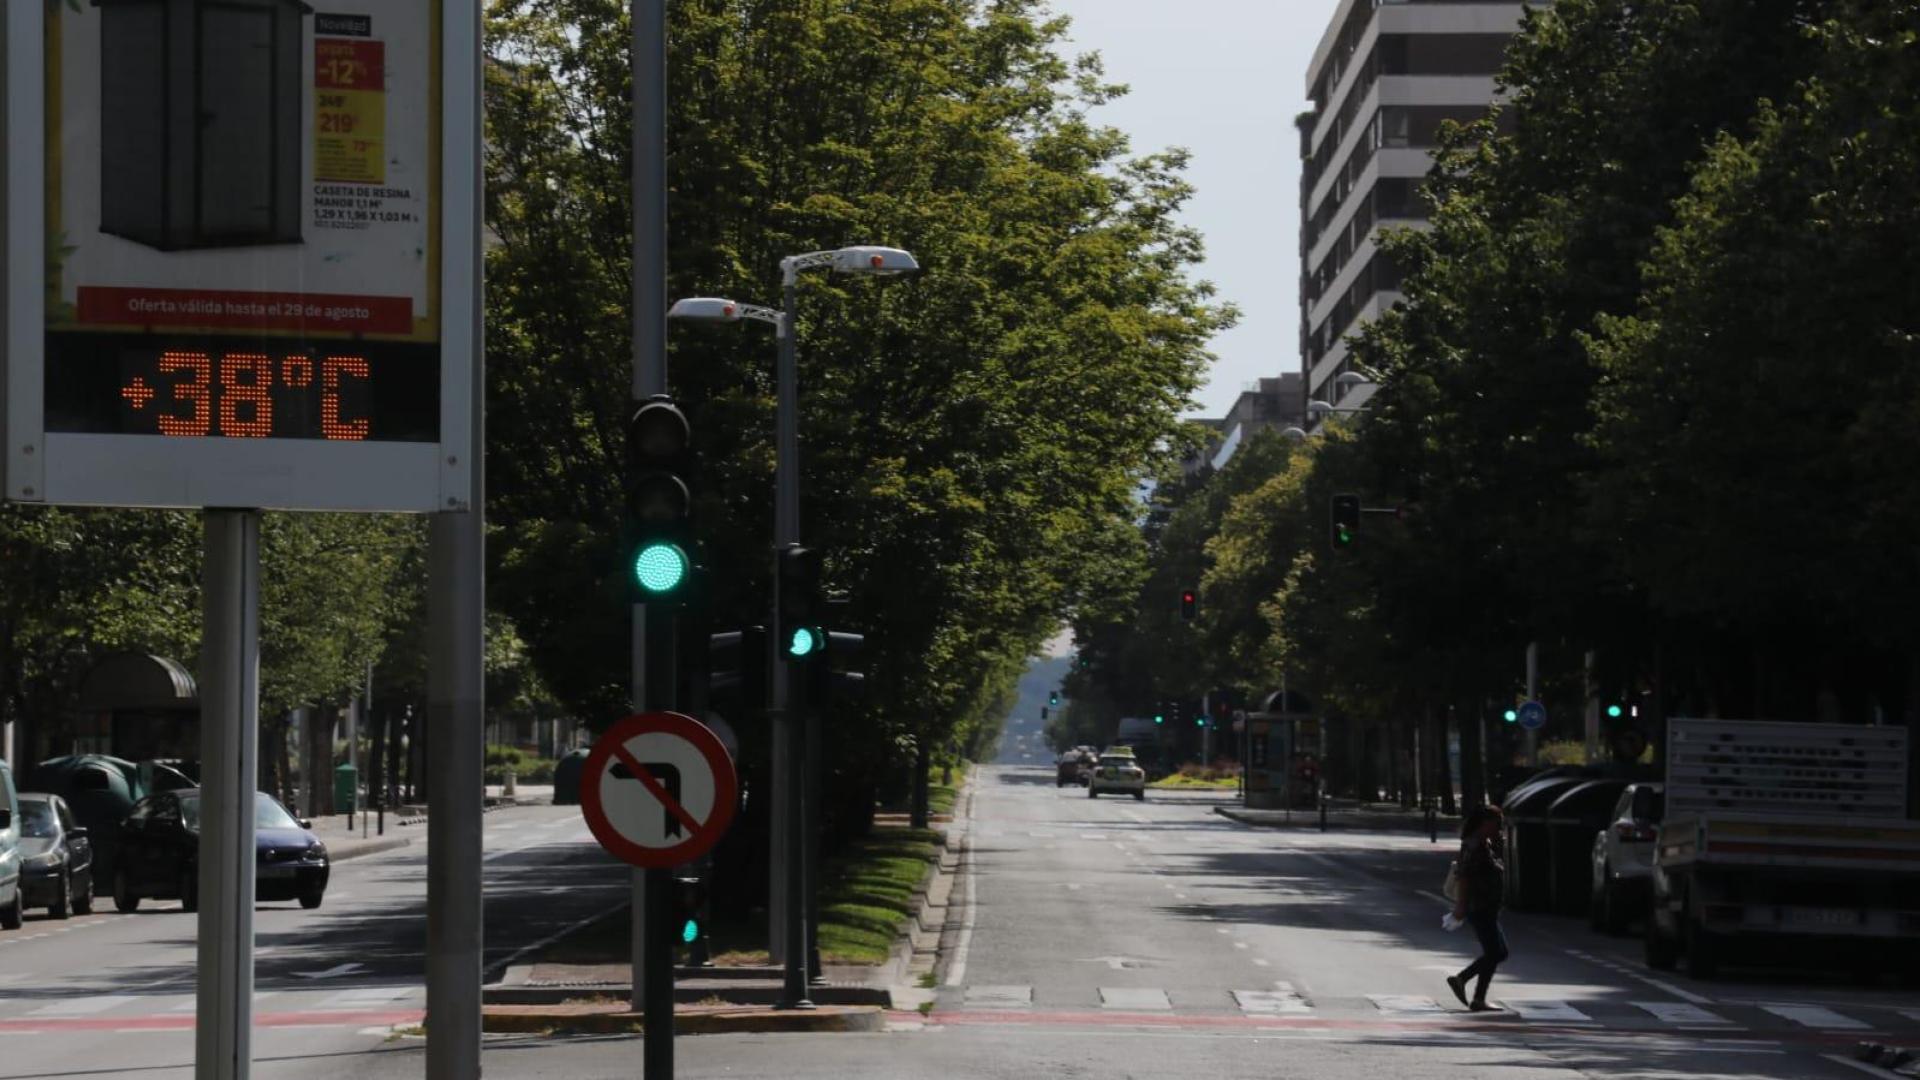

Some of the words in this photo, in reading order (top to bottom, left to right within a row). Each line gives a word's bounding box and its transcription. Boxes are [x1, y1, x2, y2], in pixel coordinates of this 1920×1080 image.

[314, 185, 354, 196] CASETA
[356, 187, 370, 197] DE
[372, 188, 411, 198] RESINA
[314, 198, 354, 208] MANOR
[314, 209, 335, 219] 1,29
[337, 210, 344, 219] X
[370, 212, 377, 221] X
[379, 212, 399, 223] 1,03
[128, 298, 176, 313] Oferta
[178, 298, 223, 314] válida
[225, 301, 265, 315] hasta
[267, 302, 281, 316] el
[284, 303, 303, 317] 29
[304, 304, 322, 317] de
[324, 306, 370, 320] agosto
